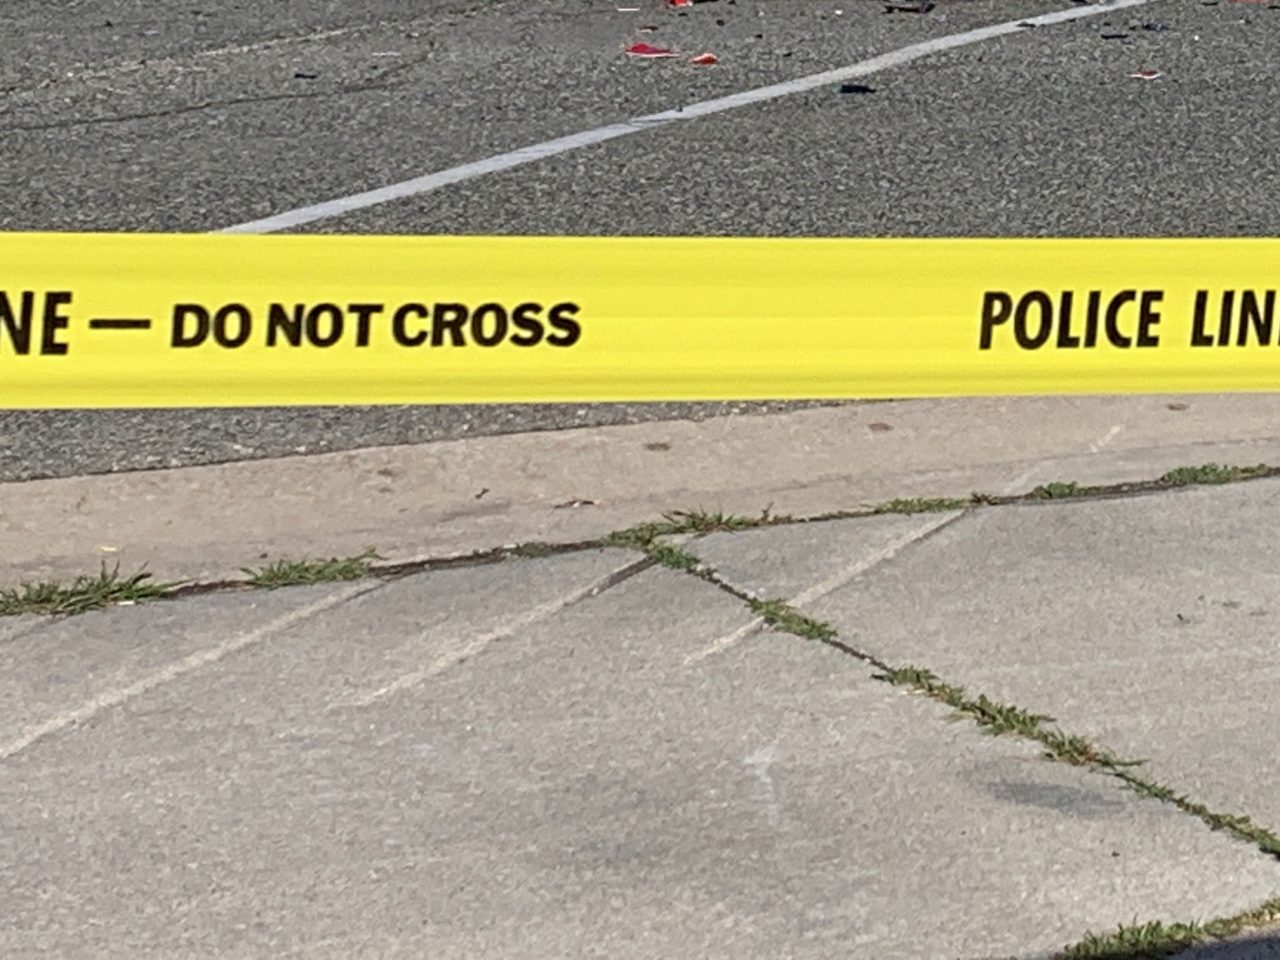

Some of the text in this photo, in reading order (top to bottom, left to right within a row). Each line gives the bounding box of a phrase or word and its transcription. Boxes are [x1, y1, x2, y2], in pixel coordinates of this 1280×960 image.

[171, 303, 252, 349] DO
[266, 303, 384, 348] NOT
[392, 302, 581, 348] CROSS
[979, 290, 1164, 350] POLICE
